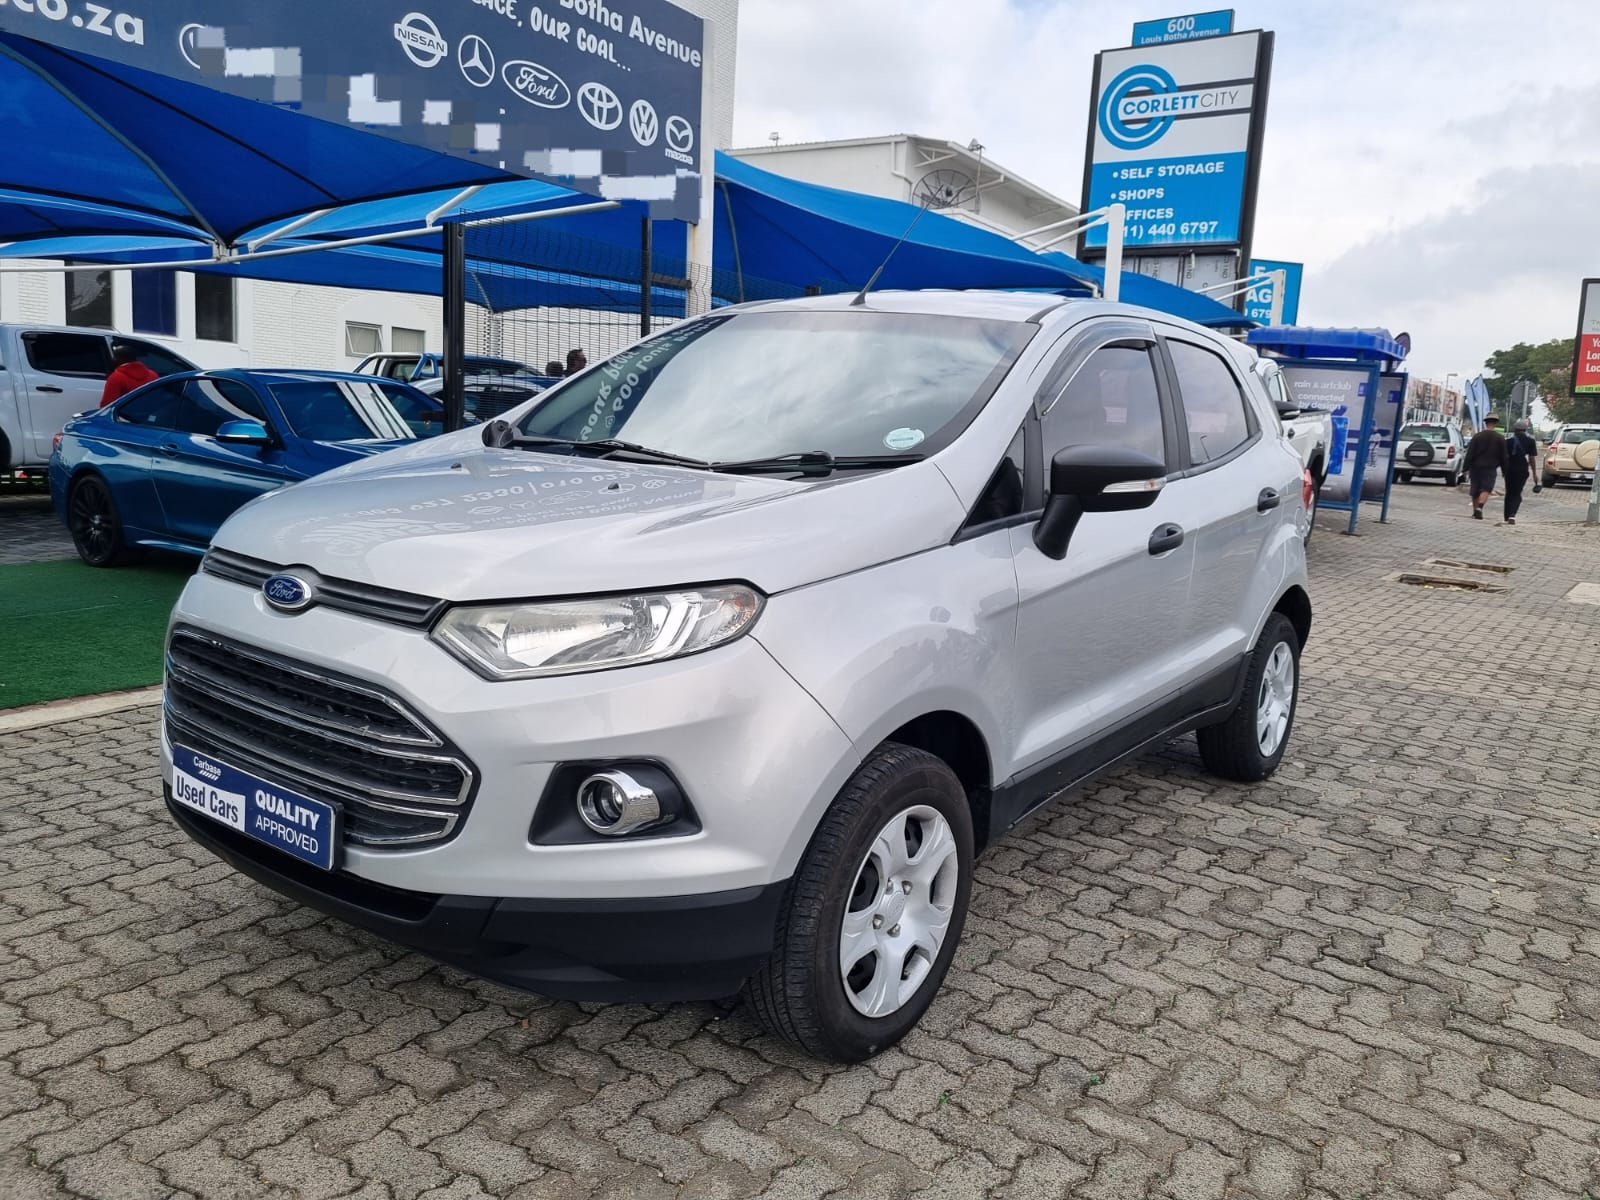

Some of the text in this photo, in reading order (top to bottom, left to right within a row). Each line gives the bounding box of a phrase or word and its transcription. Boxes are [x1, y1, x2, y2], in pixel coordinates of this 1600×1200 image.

[530, 6, 571, 43] OUR
[1167, 16, 1196, 33] 600
[397, 27, 445, 53] NISSAN
[628, 15, 702, 68] Avenue
[1140, 27, 1221, 45] Louis Botha Avenue
[514, 66, 559, 101] Ford
[1120, 161, 1225, 179] SELF STORAGE
[1118, 187, 1165, 201] SHOPS
[1124, 207, 1174, 221] FFICES
[1148, 223, 1176, 236] 440
[1180, 221, 1218, 235] 6797
[1297, 393, 1345, 402] connected
[1311, 401, 1341, 410] design
[193, 755, 222, 776] Carbase
[176, 775, 239, 823] Used Cars
[255, 789, 320, 831] QUALITY
[255, 814, 319, 854] APPROVED
